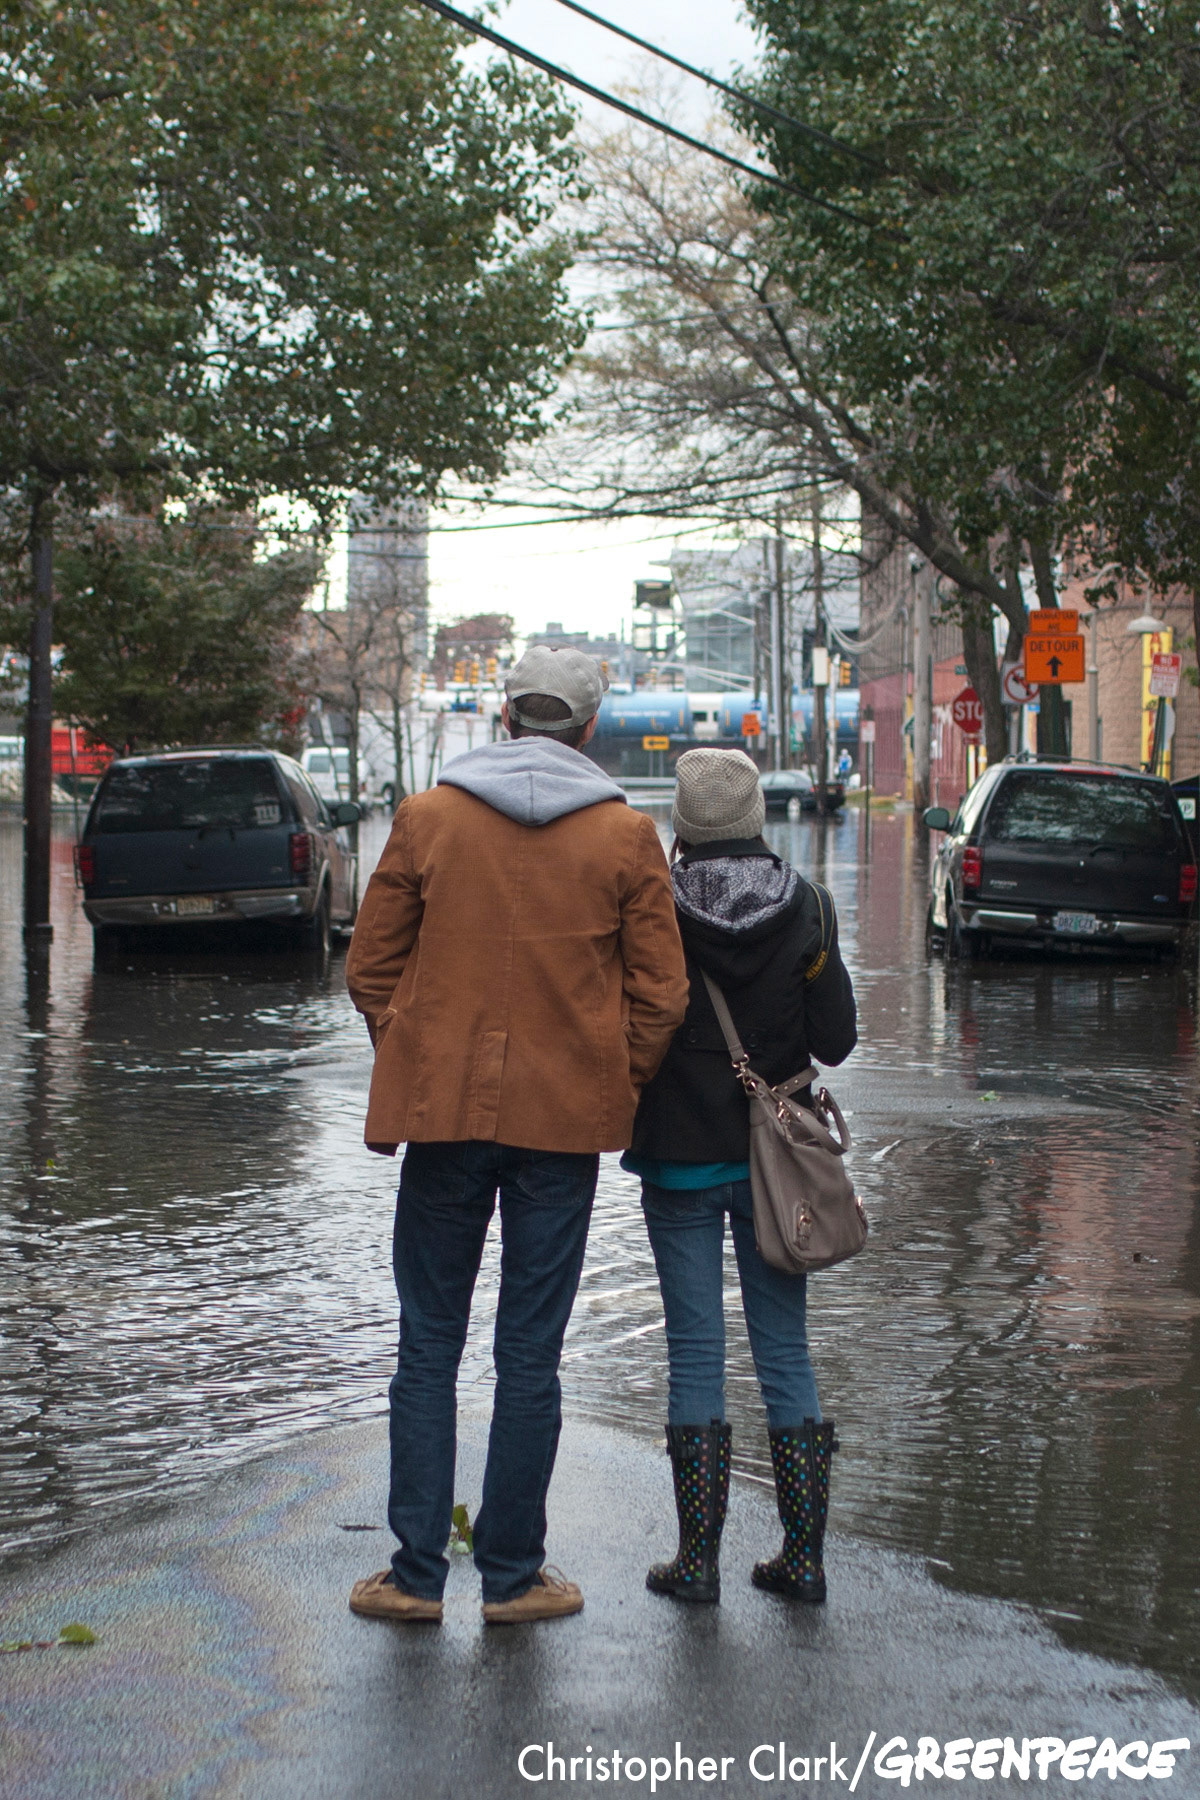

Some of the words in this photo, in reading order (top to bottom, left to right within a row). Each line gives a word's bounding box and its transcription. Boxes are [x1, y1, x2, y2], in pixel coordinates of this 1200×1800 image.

[1030, 640, 1079, 652] DETOUR
[1160, 655, 1173, 665] NO
[954, 700, 983, 721] STO
